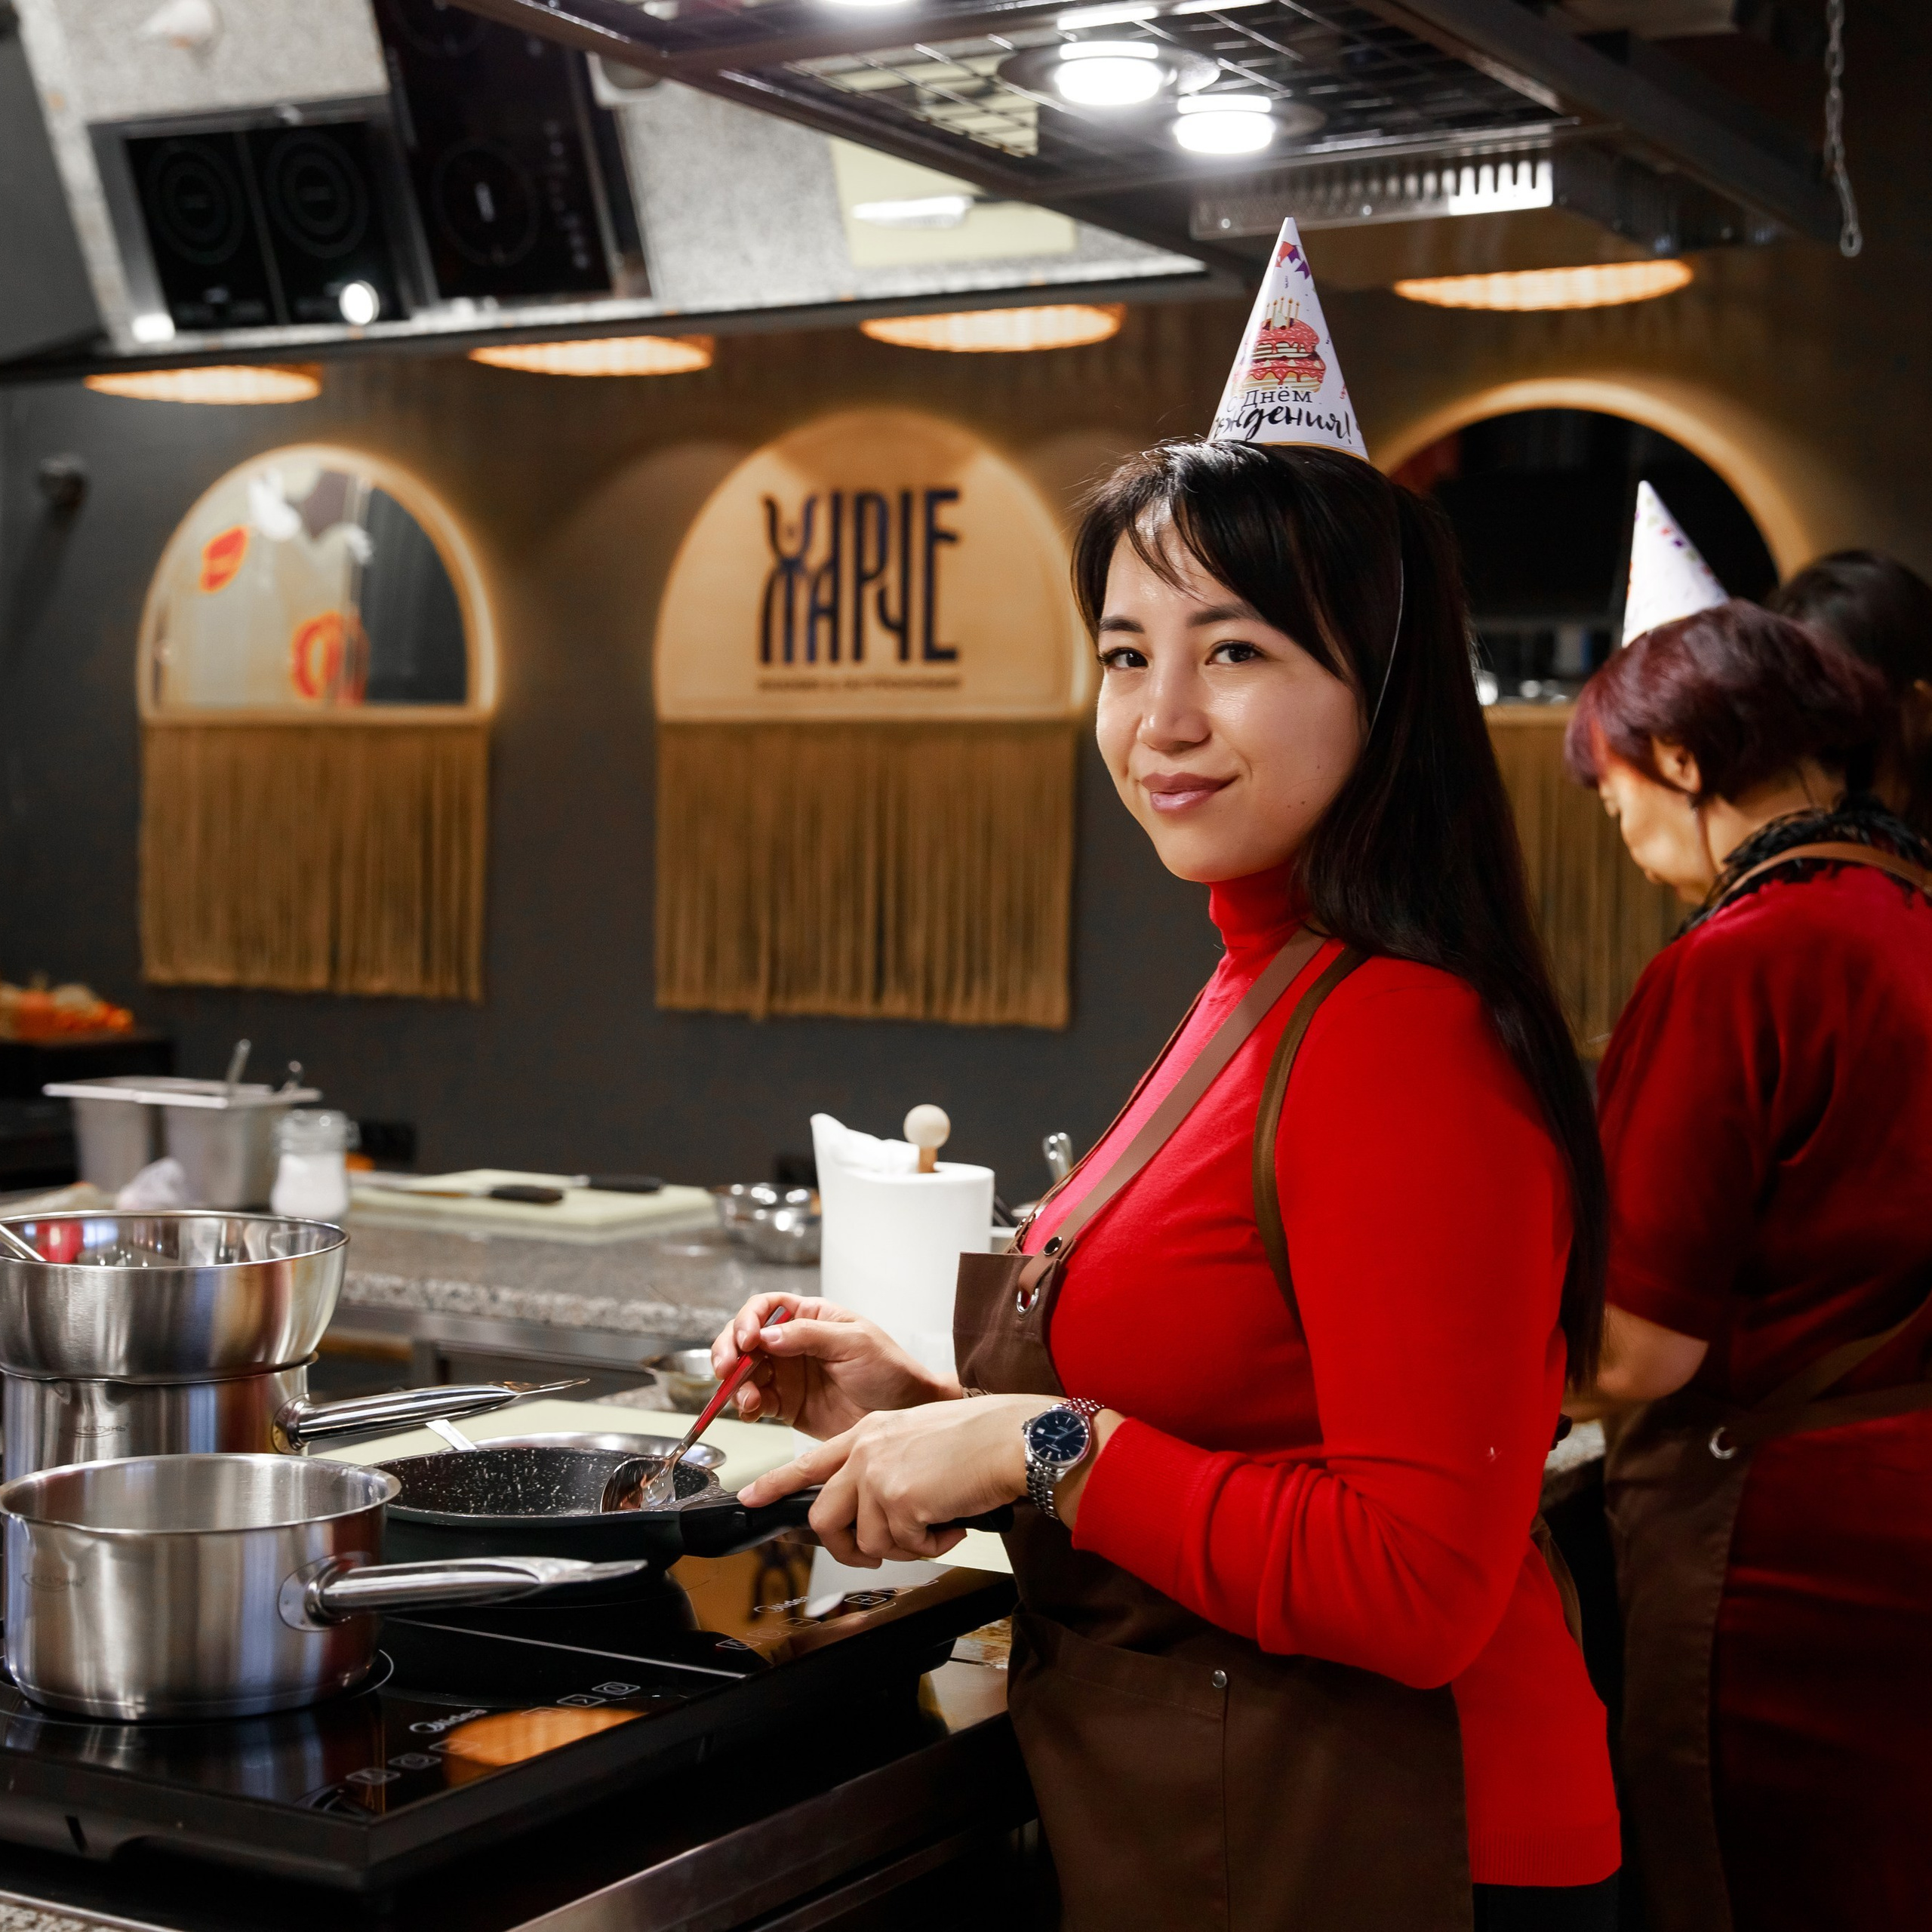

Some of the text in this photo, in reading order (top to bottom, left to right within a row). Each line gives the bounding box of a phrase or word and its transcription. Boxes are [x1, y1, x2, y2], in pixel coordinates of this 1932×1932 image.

[1241, 386, 1313, 411] Днём
[1213, 405, 1352, 443] ждения!
[759, 486, 961, 665] ЖАРЧЕ
